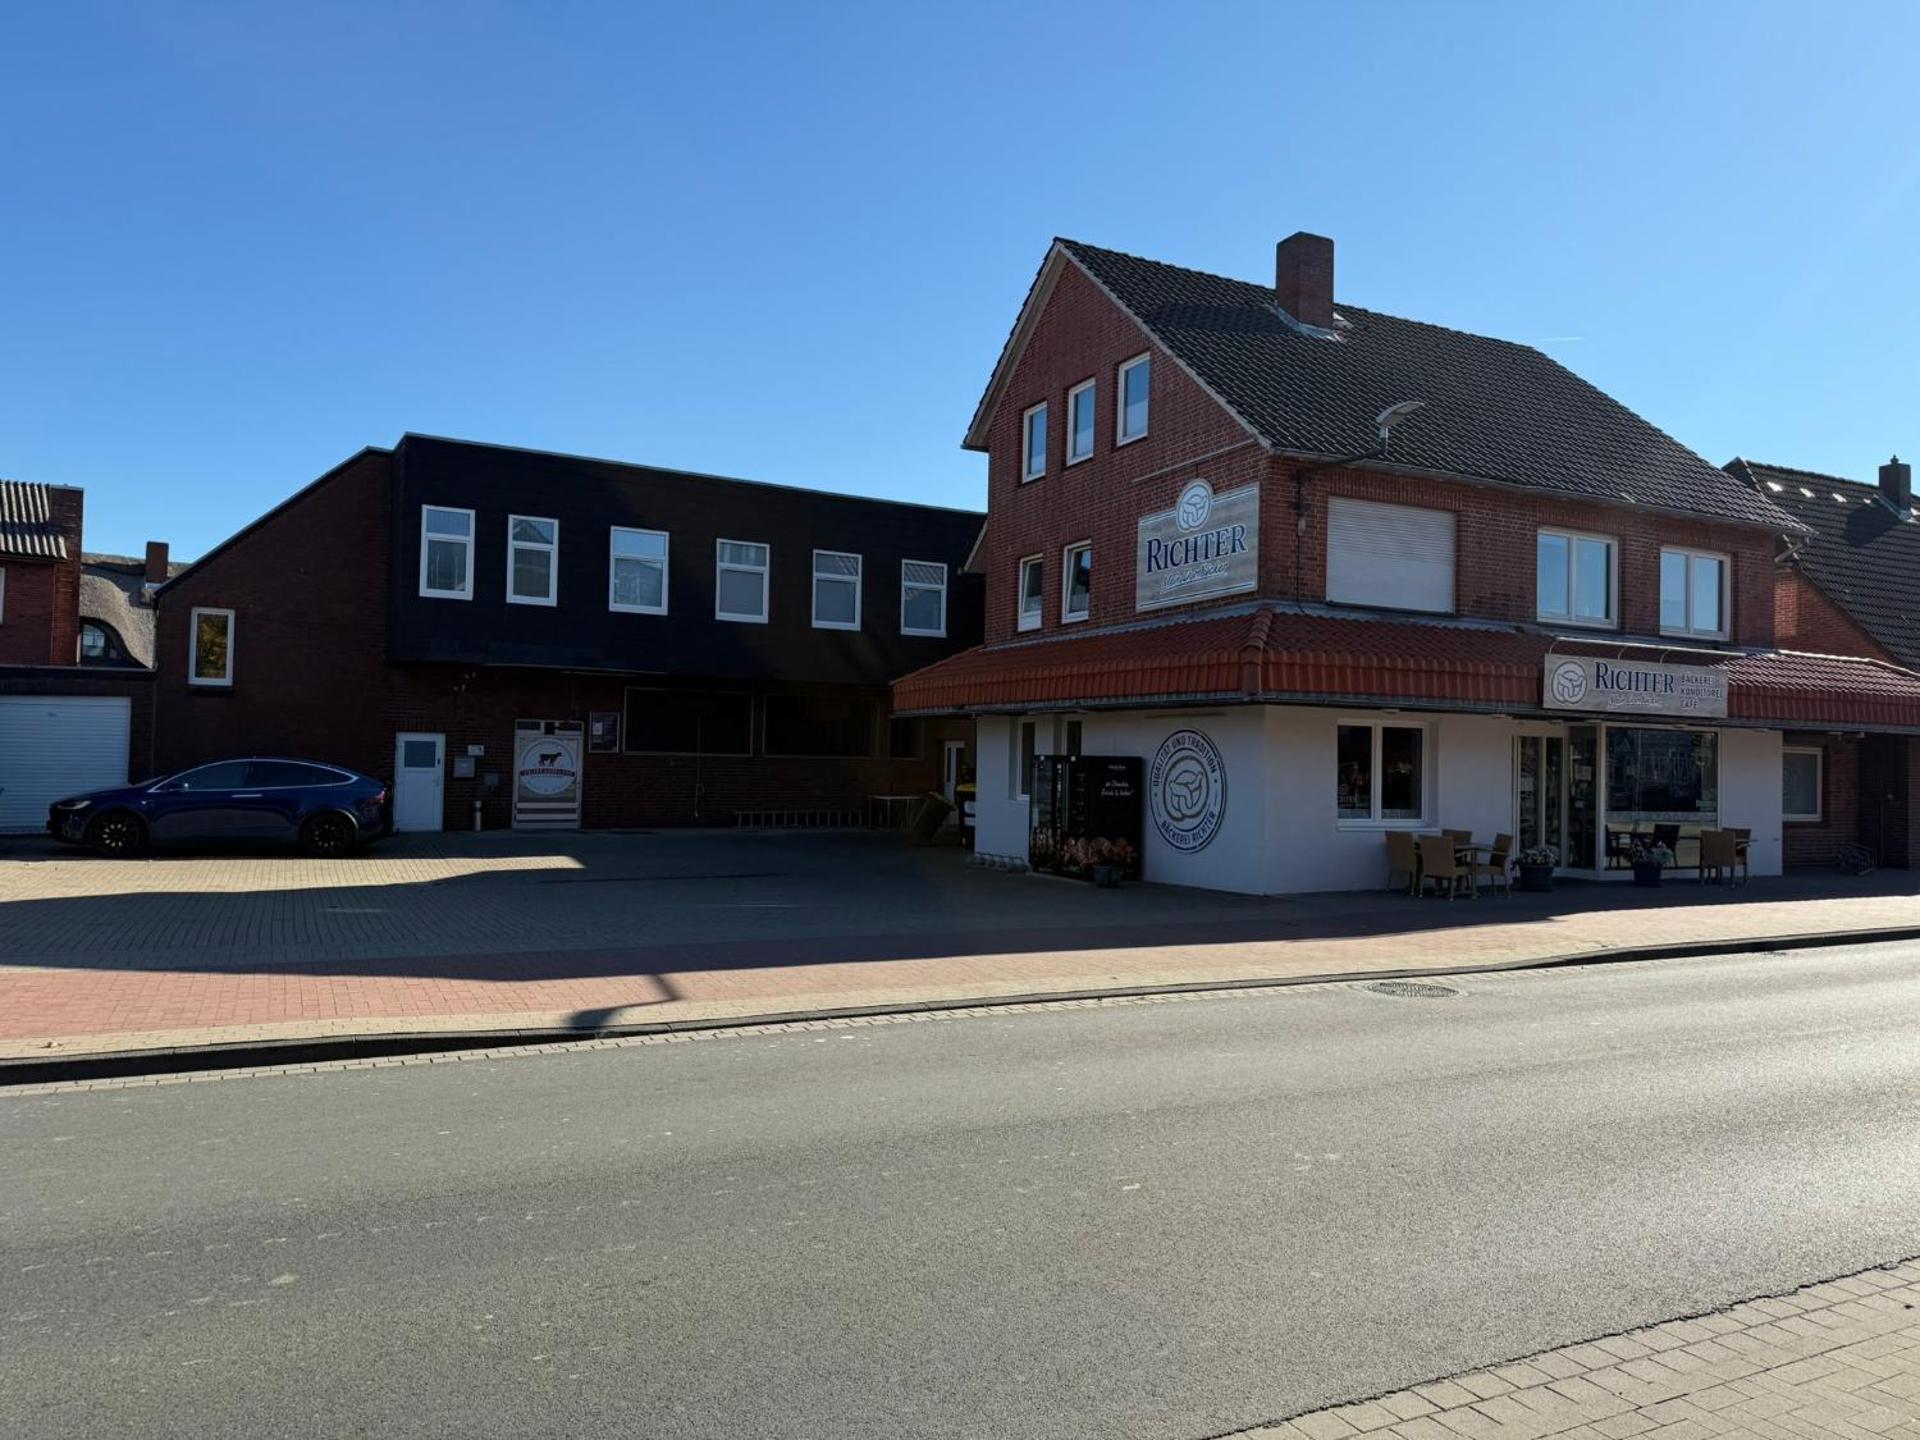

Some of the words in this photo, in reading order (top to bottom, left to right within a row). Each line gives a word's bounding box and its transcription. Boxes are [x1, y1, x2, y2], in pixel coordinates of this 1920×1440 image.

[1147, 525, 1246, 573] RICHTER
[1595, 662, 1674, 694] RICHTER
[1171, 735, 1186, 749] UND
[1187, 735, 1218, 774] TRADITION
[1192, 811, 1217, 844] RICHTER
